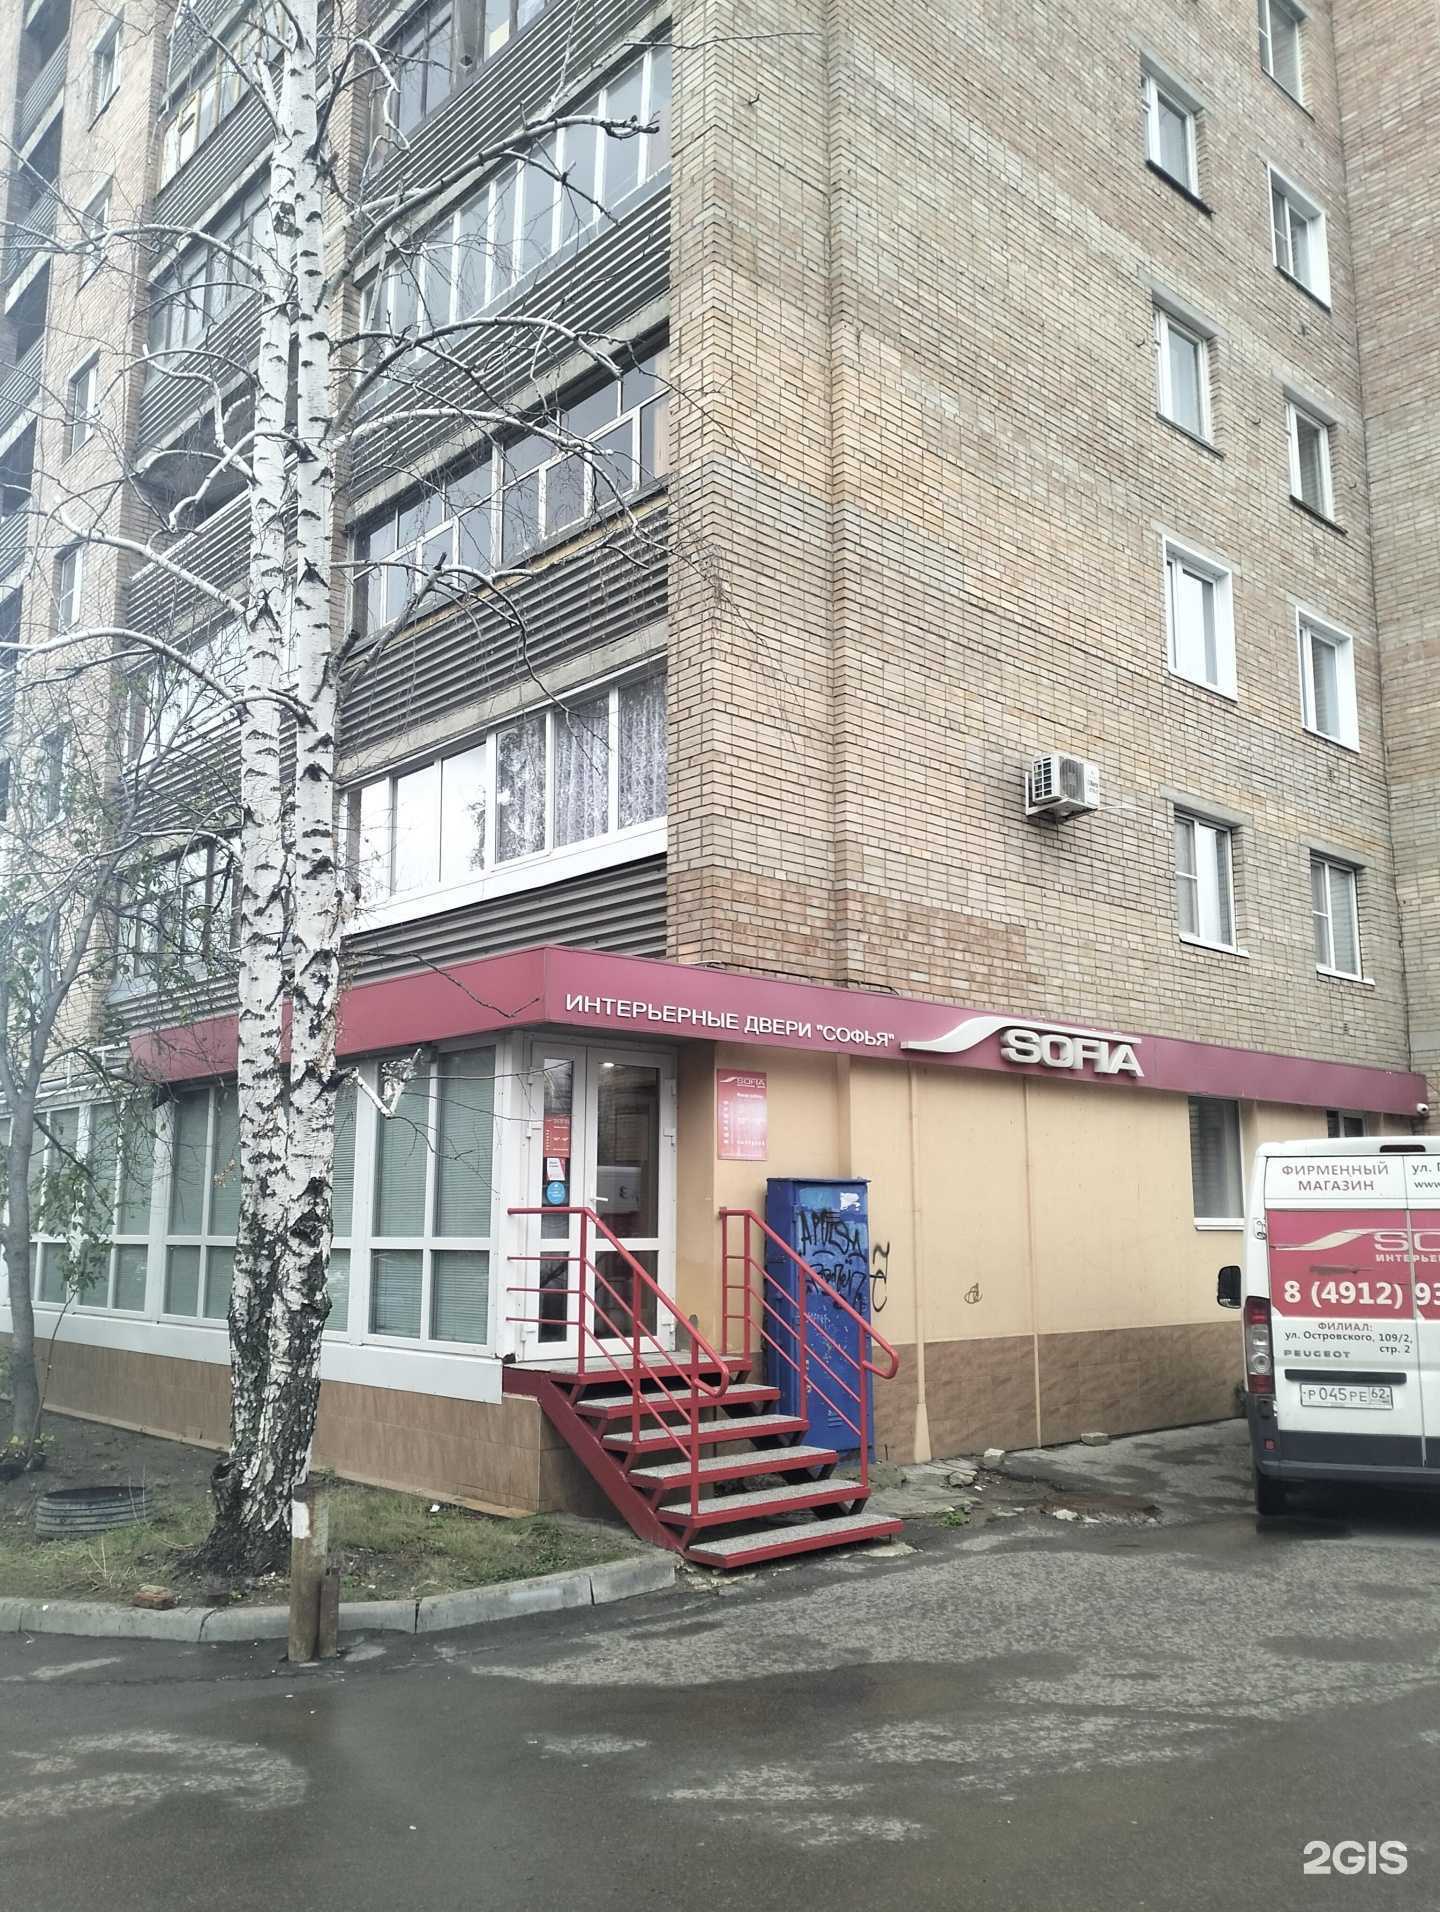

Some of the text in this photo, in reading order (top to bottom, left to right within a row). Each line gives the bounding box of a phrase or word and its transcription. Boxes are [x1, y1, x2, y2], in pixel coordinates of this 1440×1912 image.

[566, 993, 895, 1047] ИНТЕРЬЕРНЫЕ ДВЕРИ "СОФЬЯ"
[1002, 1028, 1144, 1077] SOFIA
[1282, 1160, 1389, 1176] ФИРМЕННЫЙ
[1411, 1164, 1432, 1176] ул.
[1298, 1180, 1374, 1191] МАГАЗИН
[1375, 1254, 1440, 1263] ИНТЕРЬЕ
[1284, 1280, 1301, 1303] 8
[1311, 1281, 1403, 1309] (4912)
[1318, 1322, 1373, 1332] ФИЛИАЛ:
[1285, 1332, 1301, 1340] ул.
[1303, 1331, 1375, 1342] Островского,
[1284, 1349, 1351, 1358] PEUGEOT
[1404, 1345, 1411, 1353] 2
